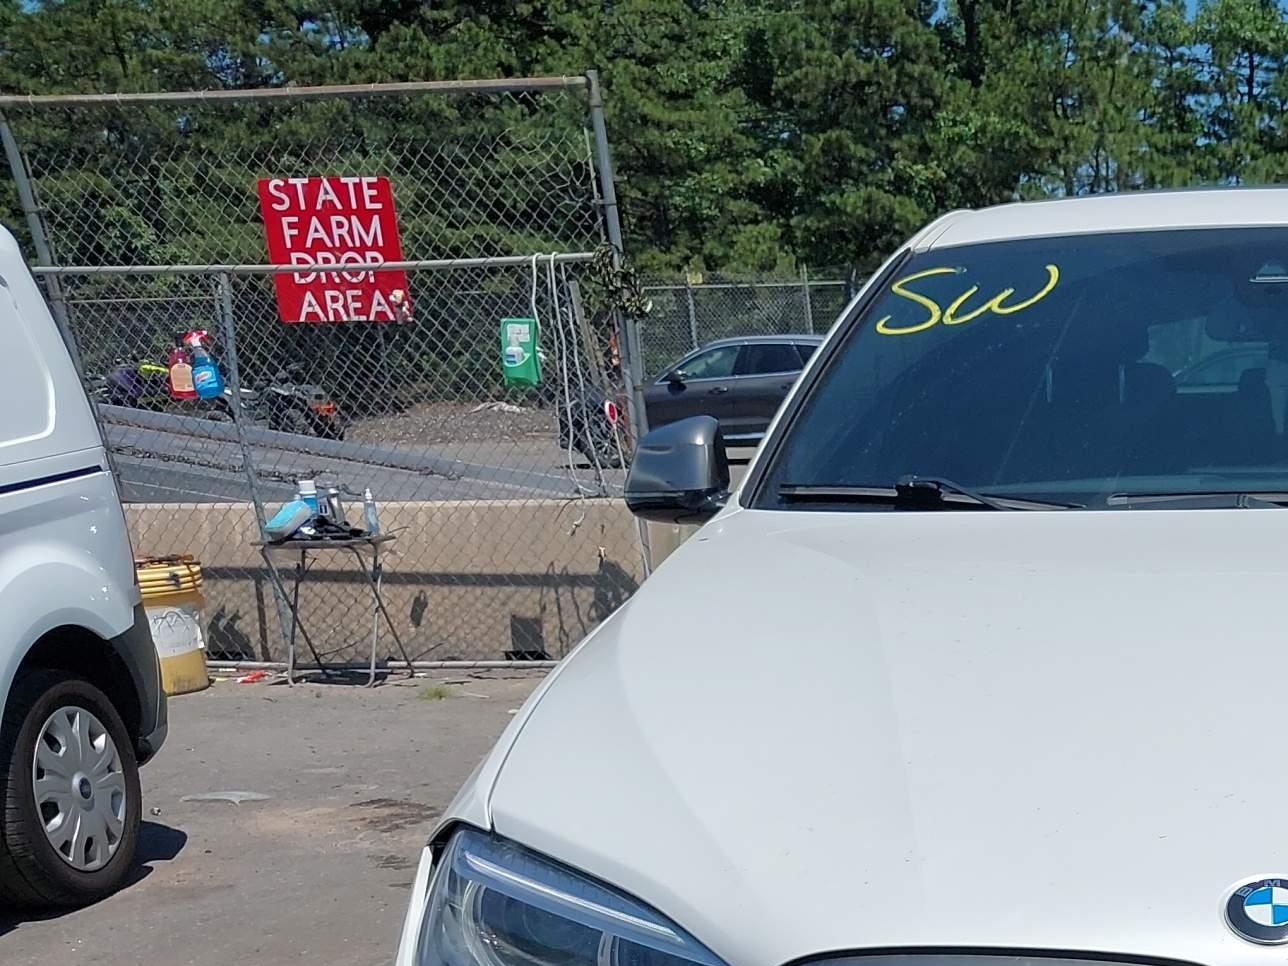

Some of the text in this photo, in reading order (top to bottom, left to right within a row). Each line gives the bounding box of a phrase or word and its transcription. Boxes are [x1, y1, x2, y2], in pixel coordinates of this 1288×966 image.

[268, 176, 383, 211] STATE
[281, 215, 384, 249] FARM
[290, 251, 385, 284] DROP
[299, 289, 397, 322] AREA
